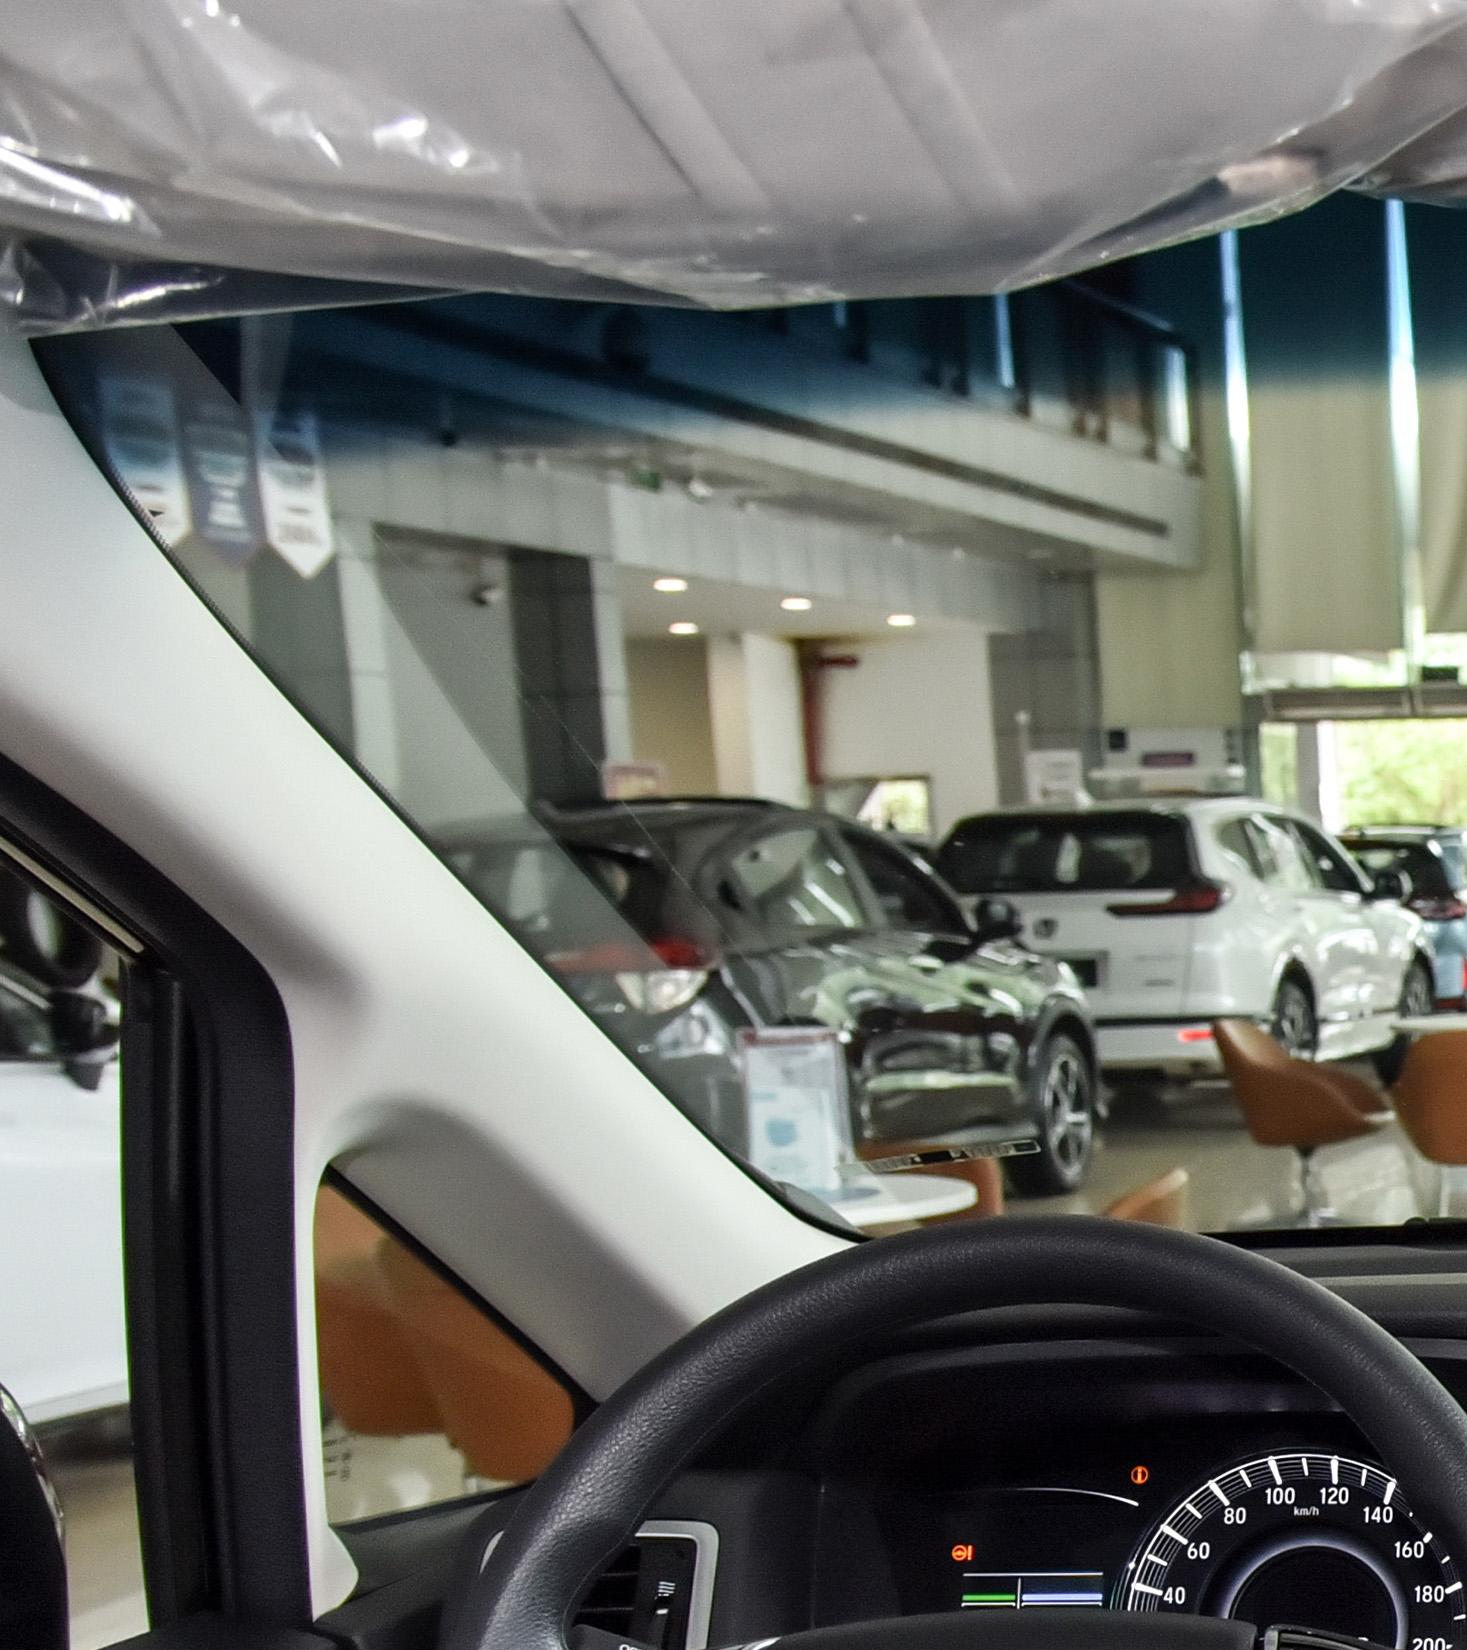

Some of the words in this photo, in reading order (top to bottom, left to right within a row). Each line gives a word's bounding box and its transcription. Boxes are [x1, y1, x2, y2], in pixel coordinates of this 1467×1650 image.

[1266, 1487, 1296, 1508] 100
[1320, 1484, 1349, 1504] 120
[1224, 1505, 1246, 1524] 80
[1294, 1506, 1319, 1515] km/h
[1364, 1504, 1393, 1523] 140
[1185, 1540, 1210, 1559] 60
[1395, 1538, 1426, 1558] 160
[1162, 1587, 1185, 1604] 40
[1415, 1585, 1446, 1602] 180
